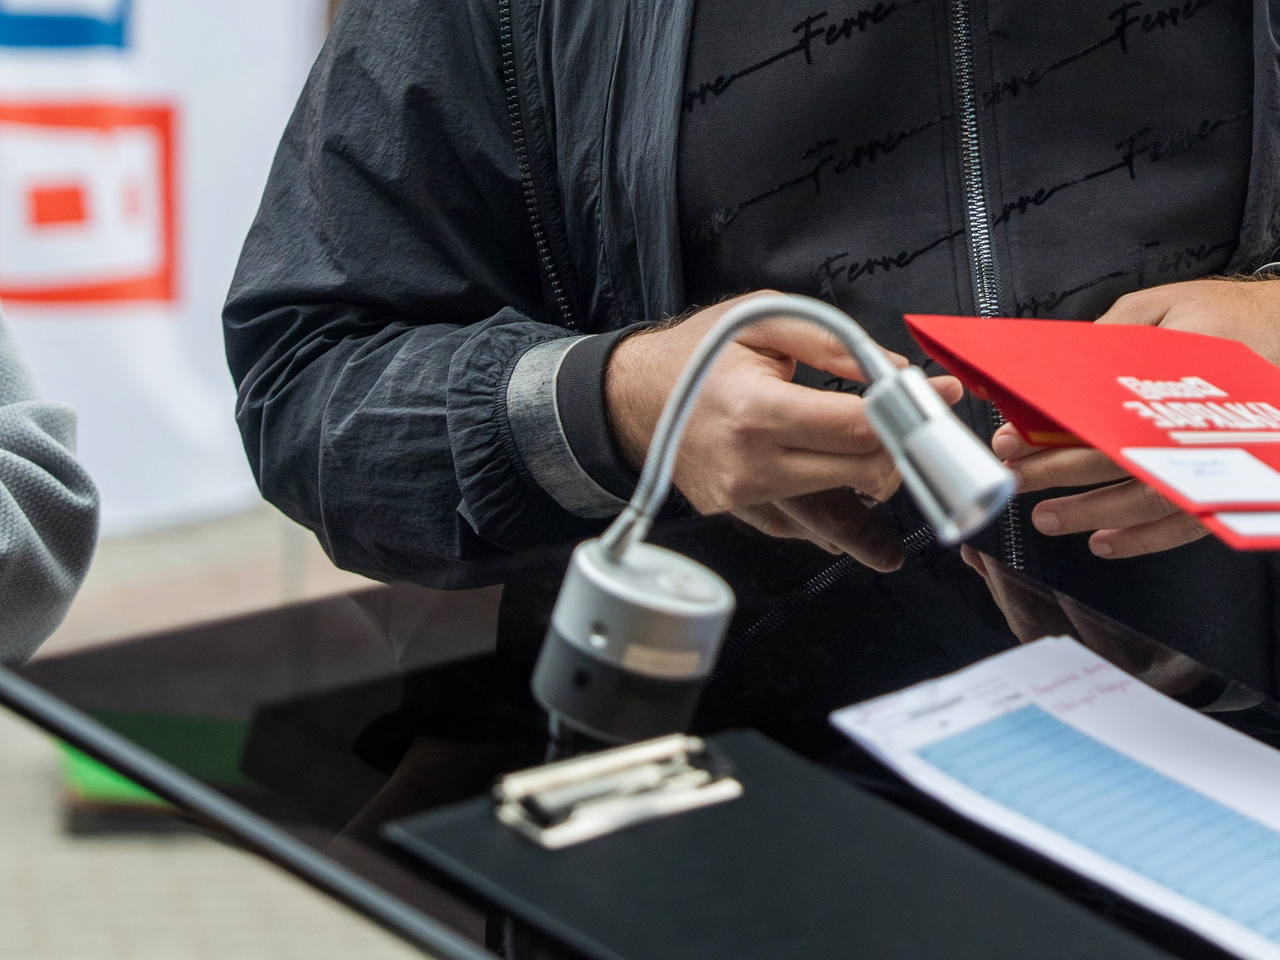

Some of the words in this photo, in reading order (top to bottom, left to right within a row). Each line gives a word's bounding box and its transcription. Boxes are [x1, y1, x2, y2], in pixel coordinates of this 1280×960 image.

[793, 3, 897, 65] Ferre
[1108, 0, 1203, 55] Ferre
[803, 132, 906, 194] Ferre
